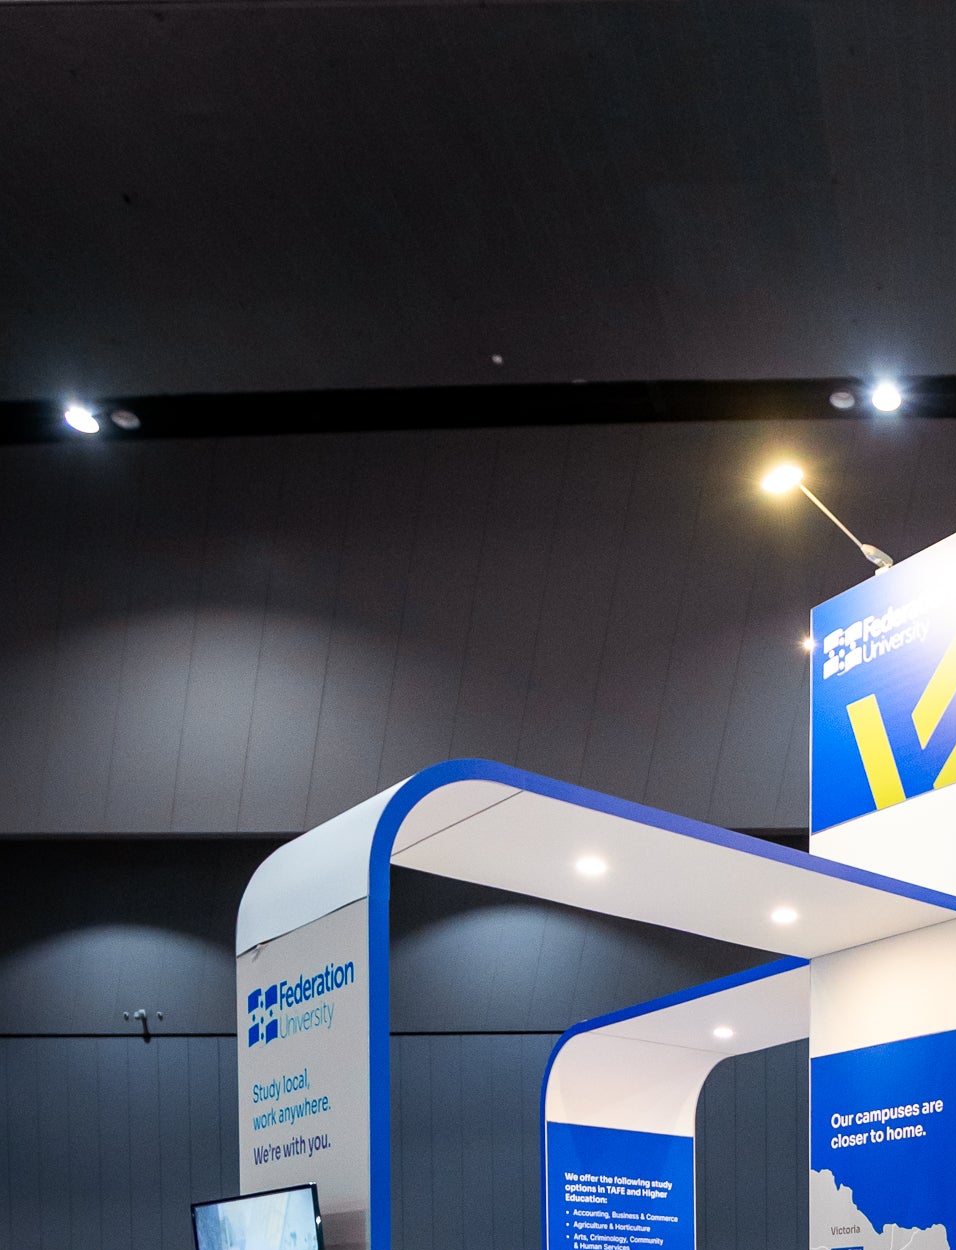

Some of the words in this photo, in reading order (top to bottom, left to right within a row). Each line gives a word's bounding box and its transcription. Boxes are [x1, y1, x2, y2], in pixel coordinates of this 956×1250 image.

[862, 618, 931, 663] University
[280, 961, 354, 1010] Federation
[280, 1002, 334, 1039] University
[253, 1078, 280, 1104] Study
[283, 1068, 310, 1093] local,
[253, 1107, 276, 1130] work
[279, 1095, 331, 1125] anywhere.
[830, 1113, 854, 1129] Our
[855, 1104, 920, 1127] campuses
[922, 1099, 944, 1114] are
[830, 1131, 868, 1149] closer
[870, 1129, 884, 1143] to
[886, 1123, 927, 1141] home.
[254, 1143, 281, 1166] We're
[283, 1137, 306, 1158] with
[308, 1134, 331, 1158] you.
[565, 1172, 578, 1181] We
[580, 1174, 598, 1182] offer
[600, 1175, 613, 1183] the
[614, 1176, 650, 1188] following
[652, 1180, 672, 1190] study
[565, 1184, 596, 1192] options
[607, 1186, 625, 1195] TAFE
[642, 1190, 667, 1199] Higher
[565, 1194, 607, 1204] Education:
[573, 1209, 610, 1219] Accounting,
[612, 1211, 639, 1220] Business
[646, 1214, 678, 1222] Commerce
[573, 1221, 608, 1229] Agriculture
[615, 1224, 650, 1232] Horticulture
[574, 1233, 588, 1241] Arts,
[590, 1234, 628, 1243] Criminology,
[630, 1236, 663, 1246] Community
[831, 1225, 861, 1236] Victoria
